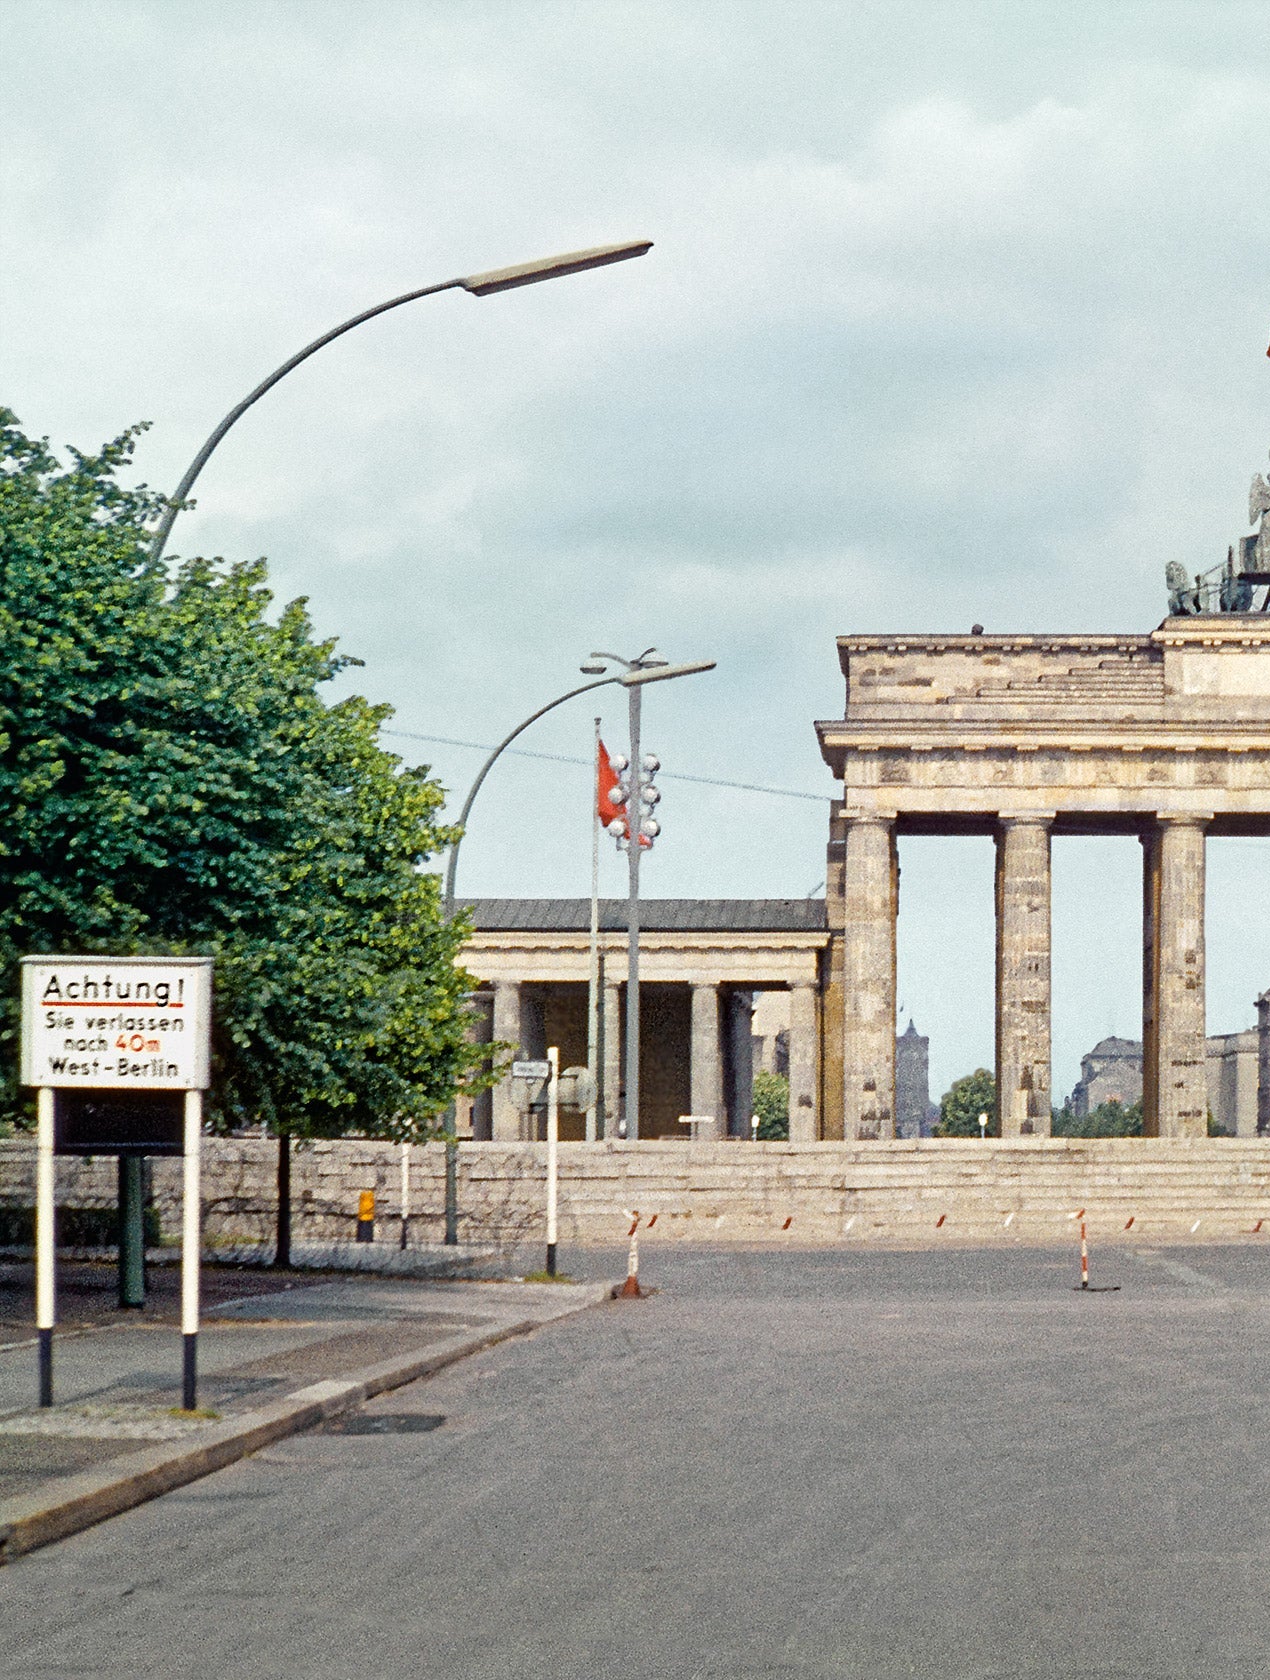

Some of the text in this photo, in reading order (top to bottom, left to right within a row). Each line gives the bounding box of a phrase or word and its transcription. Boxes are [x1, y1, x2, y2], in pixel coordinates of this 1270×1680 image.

[43, 974, 185, 1007] Achtung!
[46, 1010, 184, 1032] Sie verlassen
[64, 1033, 161, 1053] nach 40m
[48, 1056, 178, 1078] West-Berlin
